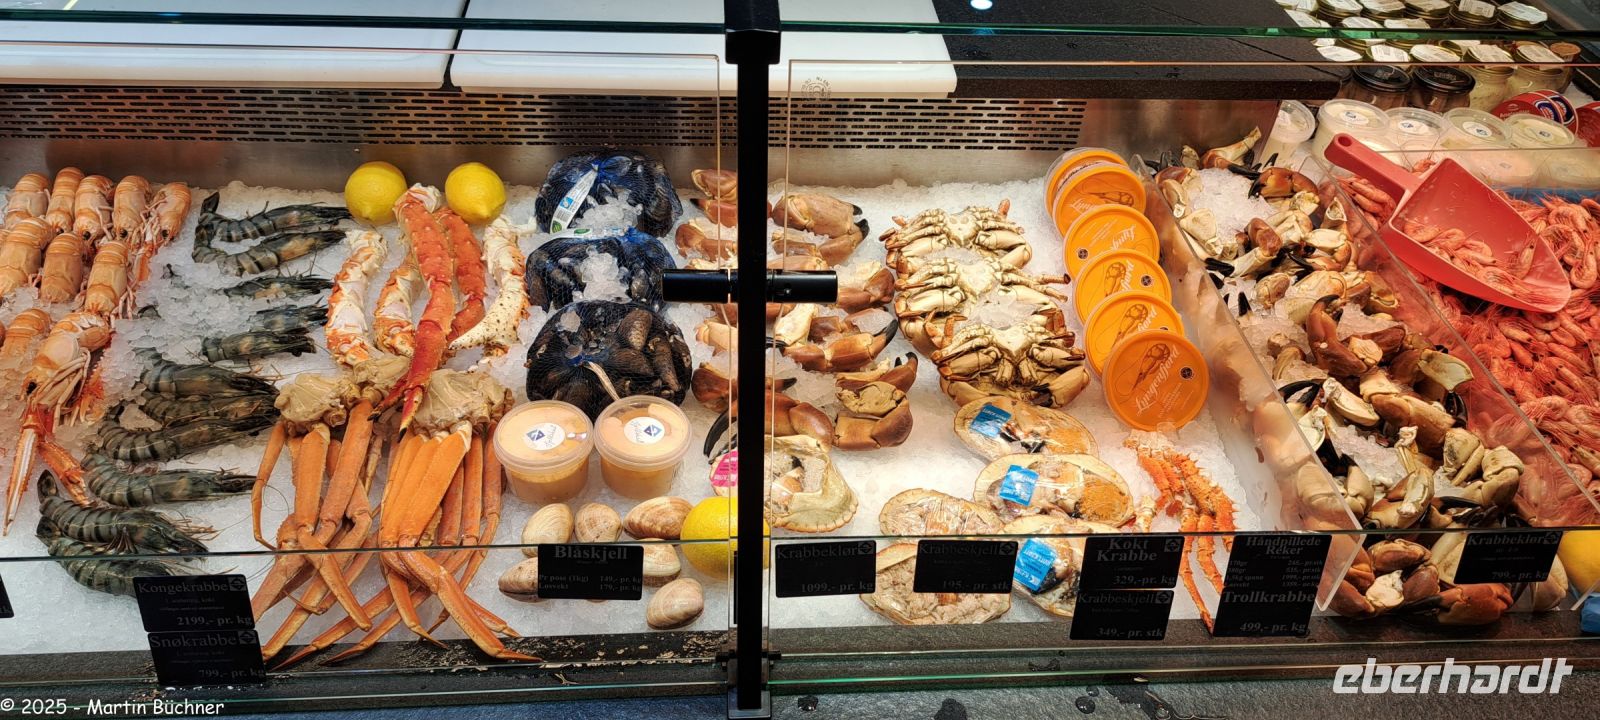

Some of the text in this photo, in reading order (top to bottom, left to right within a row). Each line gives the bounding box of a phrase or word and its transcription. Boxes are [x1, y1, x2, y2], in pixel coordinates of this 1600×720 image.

[1109, 537, 1151, 550] Kokt
[554, 545, 627, 562] Blåskjell
[1096, 549, 1158, 562] Krabbe
[1265, 545, 1304, 556] Reker
[138, 580, 229, 595] Kongekrabbe
[859, 581, 874, 592] kg
[1078, 592, 1154, 606] Krabbeskjell
[1222, 590, 1315, 603] Trollkrabbe
[236, 615, 252, 627] kg
[1290, 621, 1306, 634] kg
[149, 634, 238, 648] Snøkrabbe
